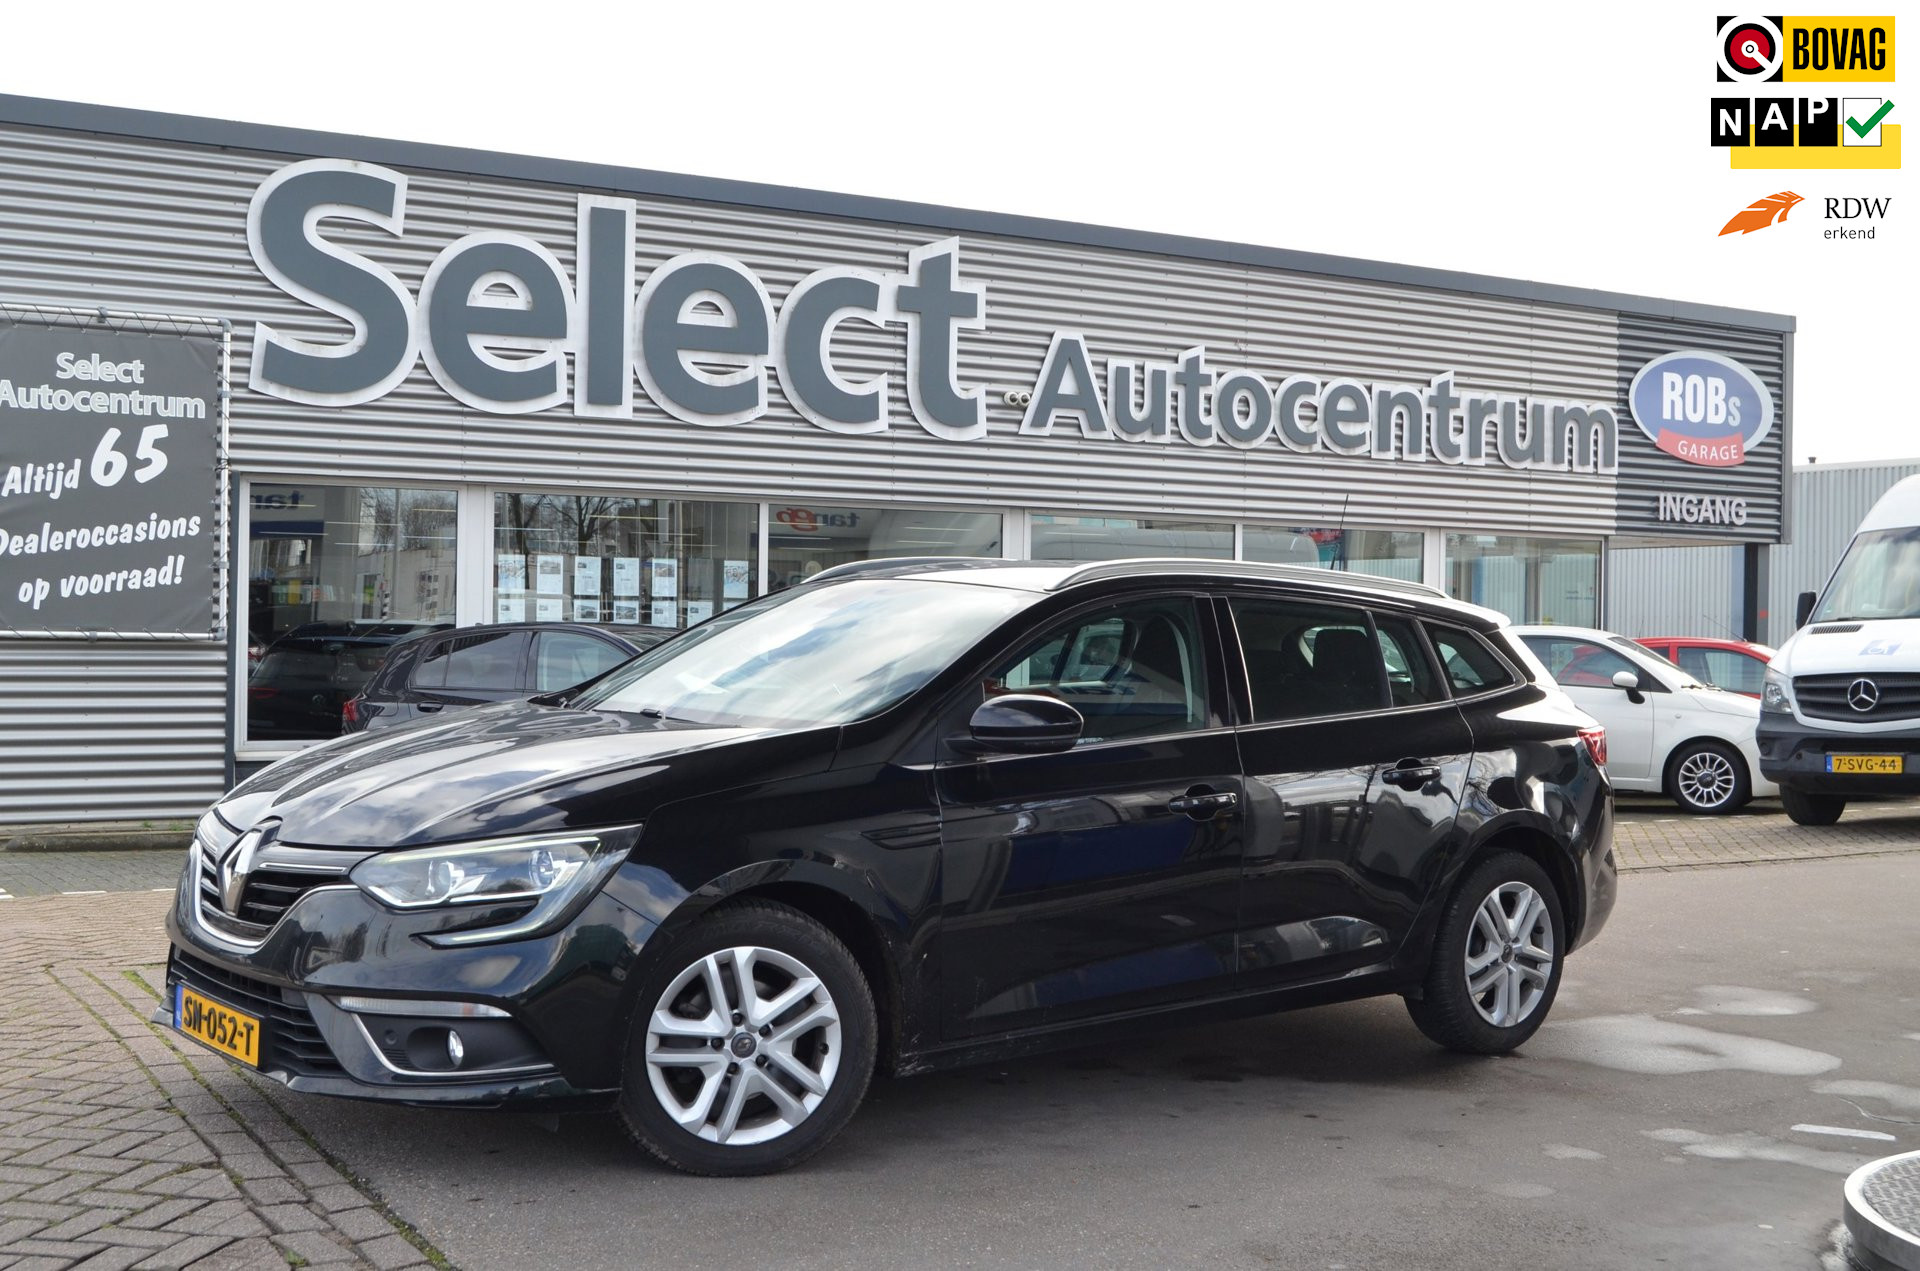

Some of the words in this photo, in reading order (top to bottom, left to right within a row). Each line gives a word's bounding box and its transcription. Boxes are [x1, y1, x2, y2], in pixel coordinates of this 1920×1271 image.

[247, 158, 988, 442] Select
[1019, 330, 1619, 476] Autocentrum
[56, 352, 145, 384] Select
[0, 379, 206, 419] Autocentrum
[1662, 371, 1741, 427] ROBs
[1, 458, 82, 500] Altijd
[90, 424, 169, 487] 65
[1677, 440, 1739, 461] GARAGE
[1658, 492, 1748, 526] INGANG
[0, 512, 201, 556] Dealeroccasions
[18, 578, 50, 610] op
[60, 555, 185, 598] voorraad!
[183, 995, 255, 1057] SN-052-T
